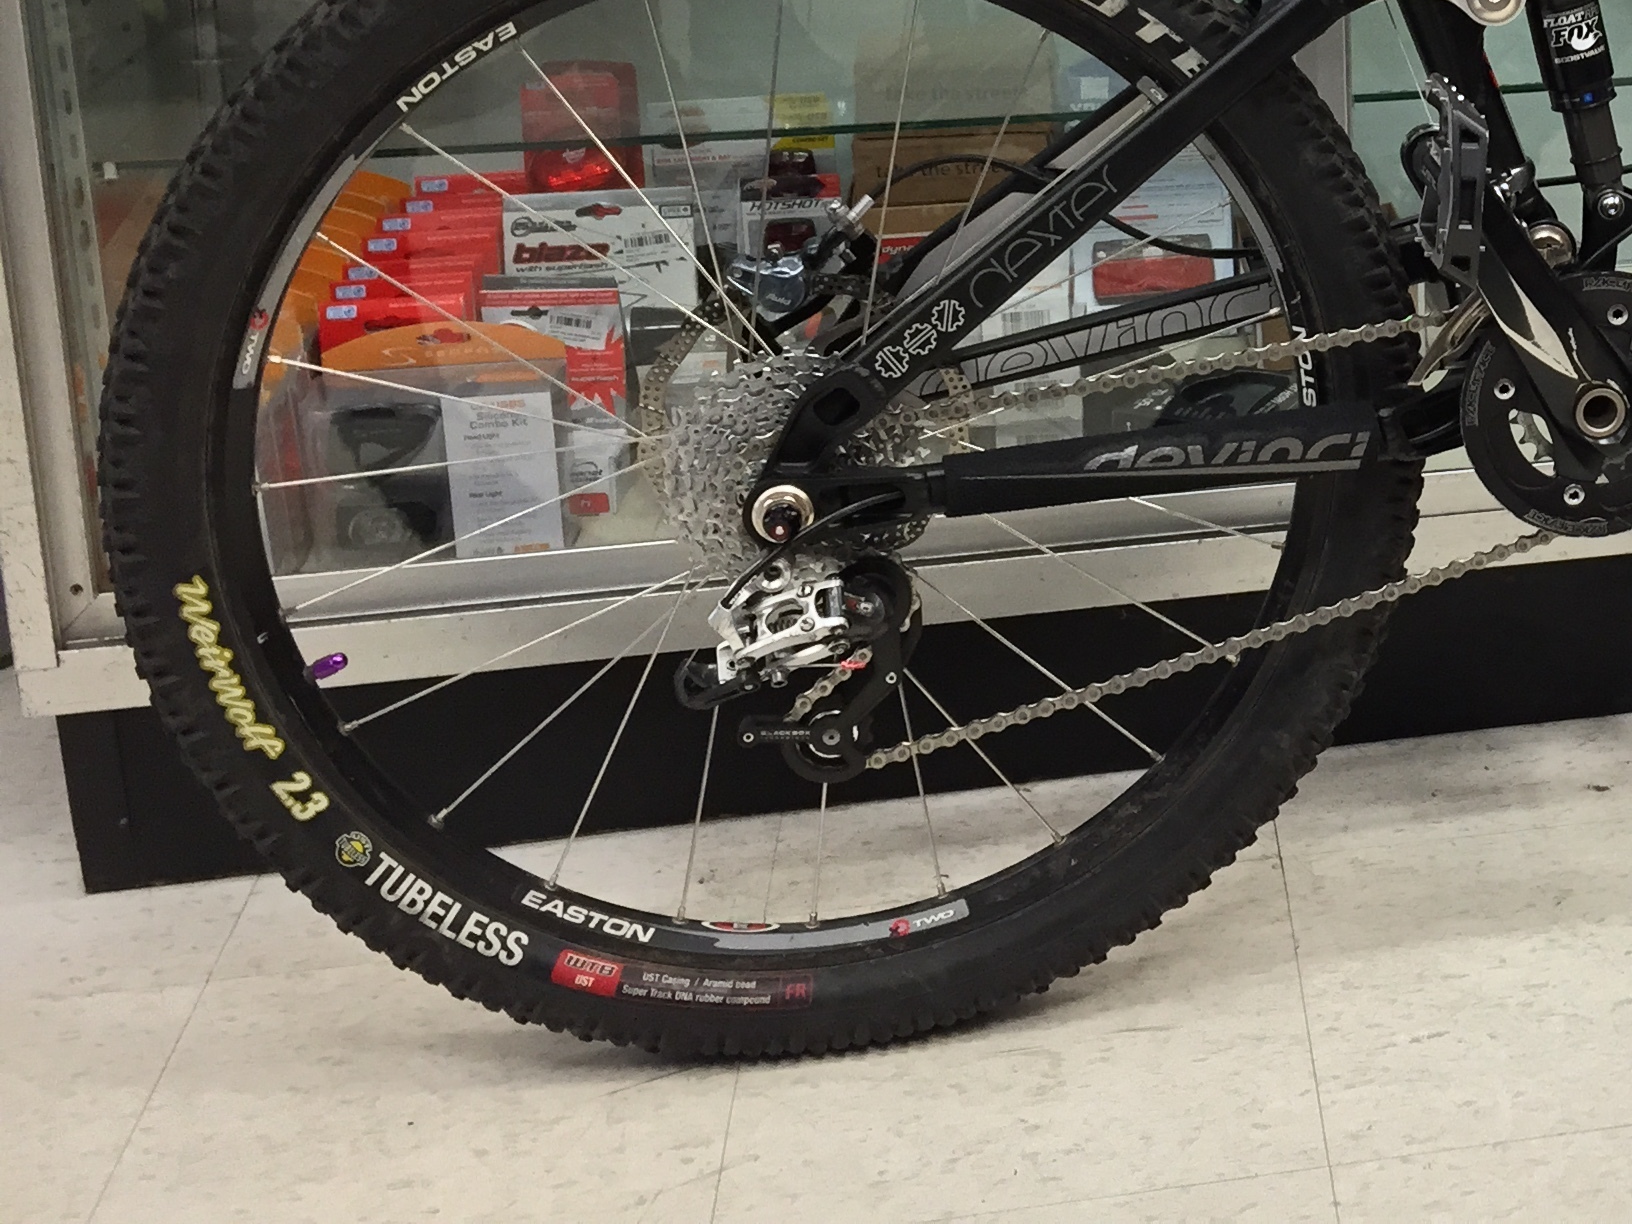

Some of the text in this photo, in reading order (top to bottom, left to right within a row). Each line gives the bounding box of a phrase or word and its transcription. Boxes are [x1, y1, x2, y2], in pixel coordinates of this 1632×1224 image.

[1542, 10, 1586, 29] FLOAT
[1551, 16, 1601, 48] FOX
[395, 19, 519, 114] EASTON
[750, 198, 820, 212] HOTSHOT
[515, 261, 609, 274] with superflash
[241, 332, 260, 376] TWO
[1083, 429, 1371, 473] devinci
[171, 573, 287, 761] WeirWolf
[268, 770, 330, 822] 2.3
[361, 851, 530, 969] TUBELESS
[520, 887, 657, 944] EASTON
[912, 908, 957, 929] TWO
[562, 952, 620, 977] WTB
[574, 971, 734, 990] UST UST Casing Aramid
[785, 982, 808, 998] FR
[622, 984, 771, 1007] Super Track DNA rubber compound
